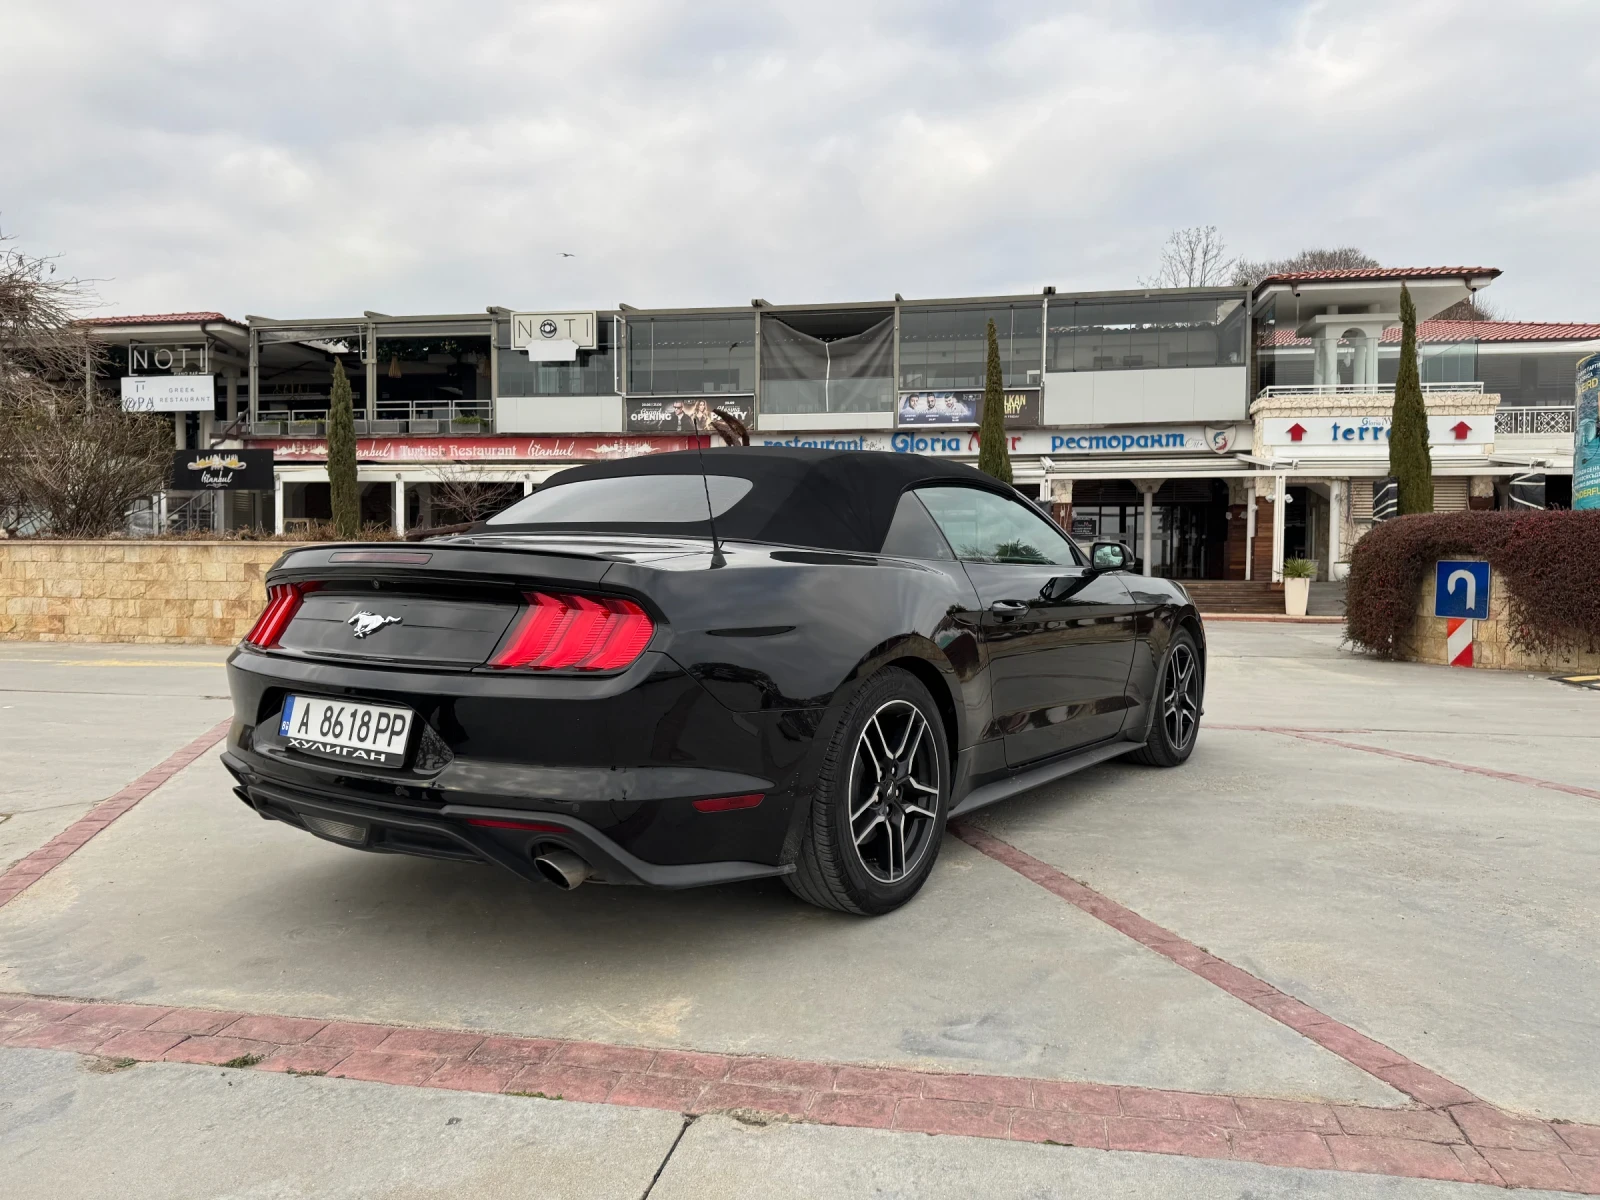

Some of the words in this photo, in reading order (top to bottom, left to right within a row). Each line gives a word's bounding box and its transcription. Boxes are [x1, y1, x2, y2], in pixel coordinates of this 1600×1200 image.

[133, 348, 203, 370] NOTI
[1004, 394, 1026, 406] LKAN
[630, 412, 672, 421] OPENING
[1361, 417, 1380, 426] Gloria
[400, 445, 445, 457] Turkish
[449, 445, 517, 457] Restaurant
[891, 431, 960, 453] Gloria
[1051, 433, 1184, 452] ресторант
[297, 702, 310, 735] A
[288, 738, 386, 762] ХУЛИГАН
